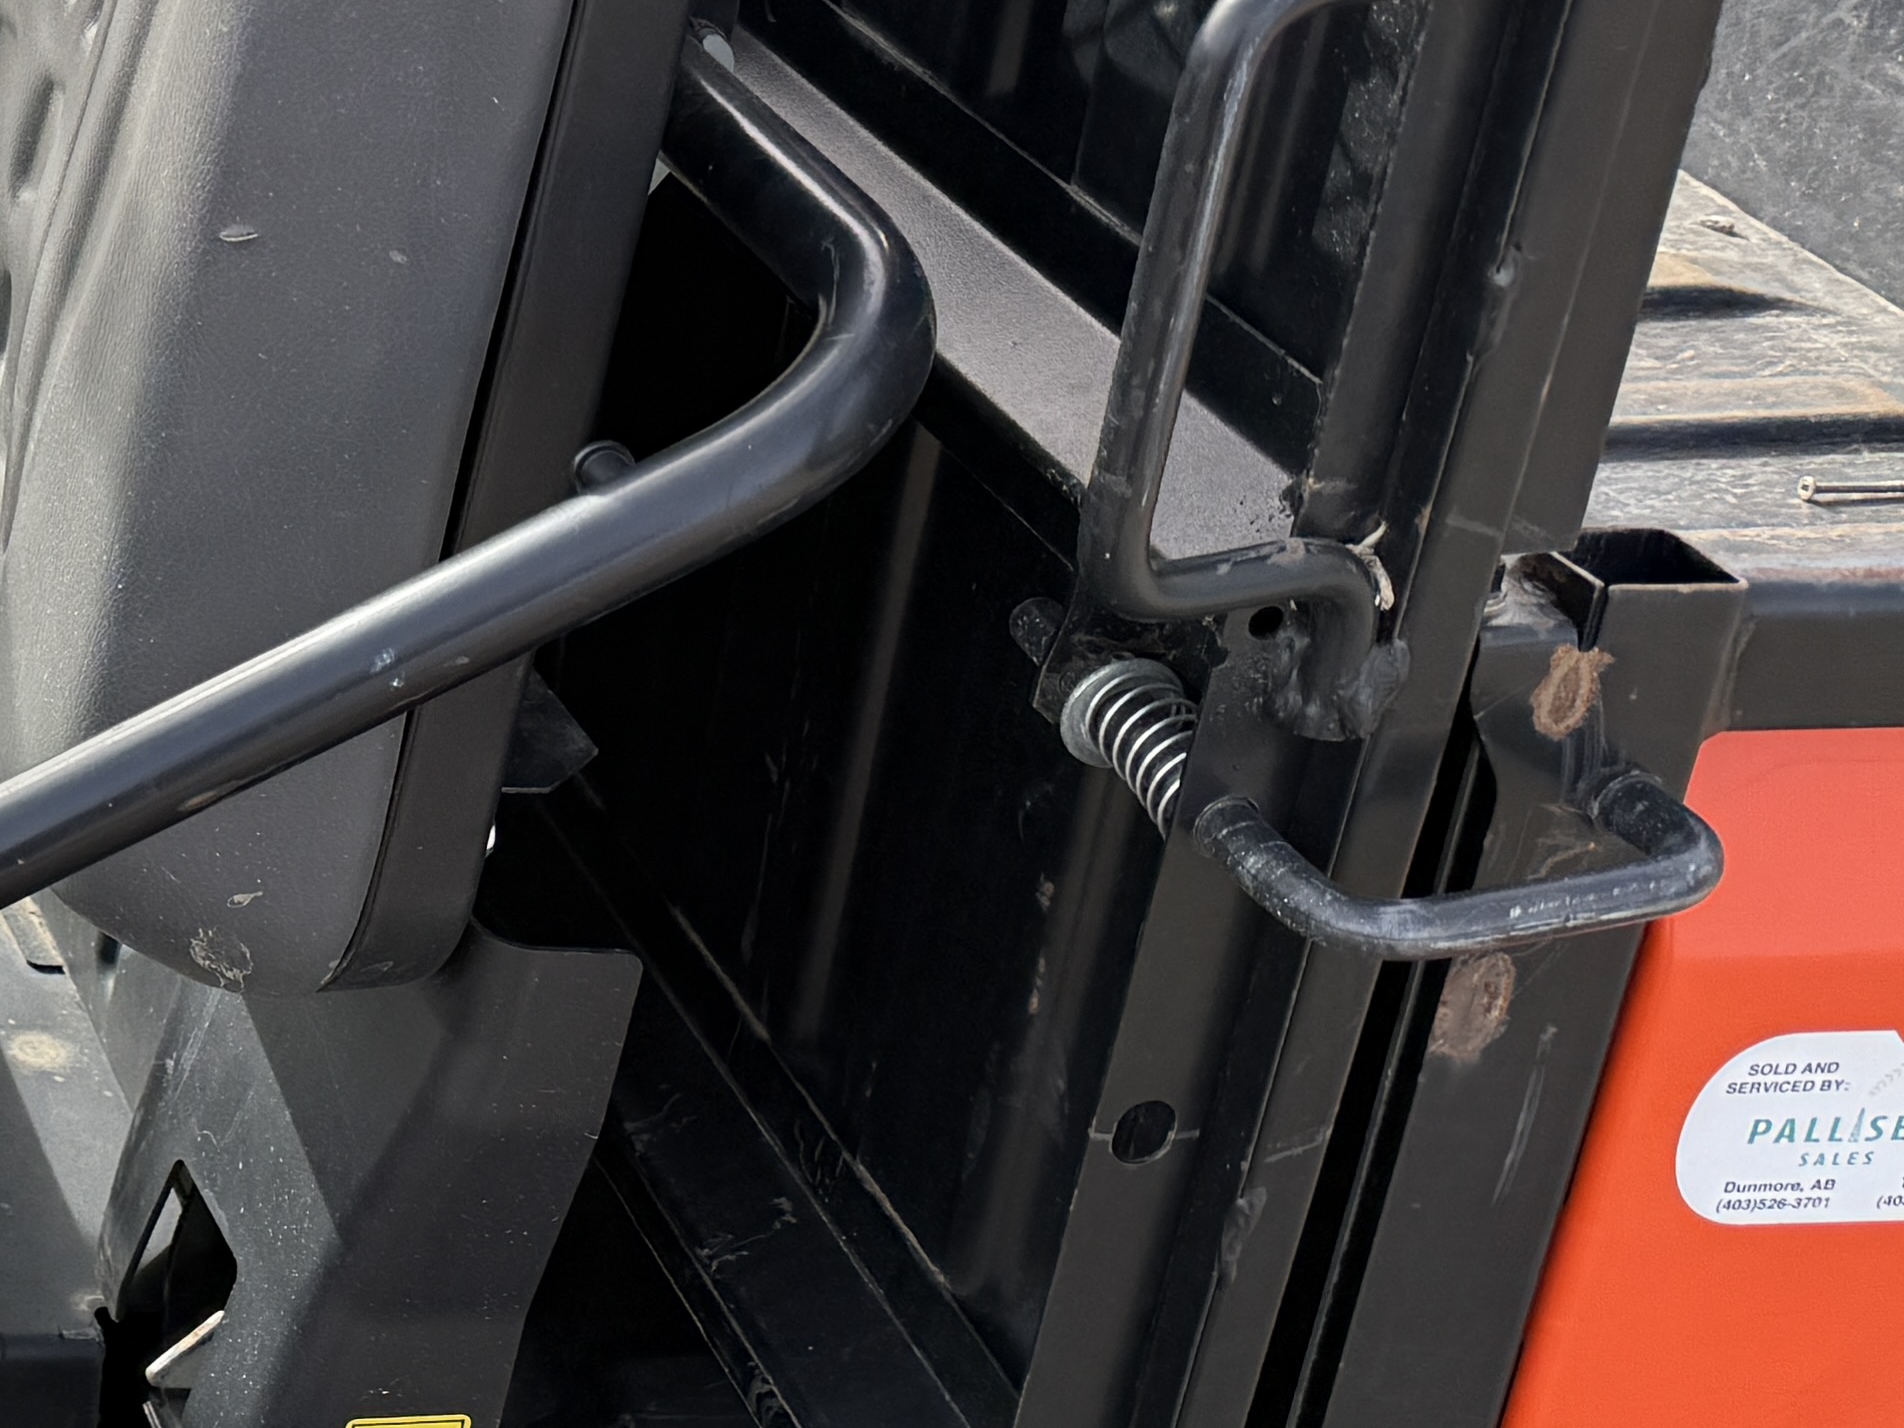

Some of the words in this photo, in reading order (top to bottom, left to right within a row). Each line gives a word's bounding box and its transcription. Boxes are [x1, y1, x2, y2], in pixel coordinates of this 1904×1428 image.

[1748, 1063, 1796, 1077] SOLD
[1801, 1061, 1839, 1074] AND
[1726, 1080, 1815, 1095] SERVICED
[1819, 1079, 1850, 1092] BY:
[1798, 1151, 1875, 1167] SALES
[1723, 1180, 1804, 1194] Dunmore,
[1811, 1178, 1836, 1191] AB
